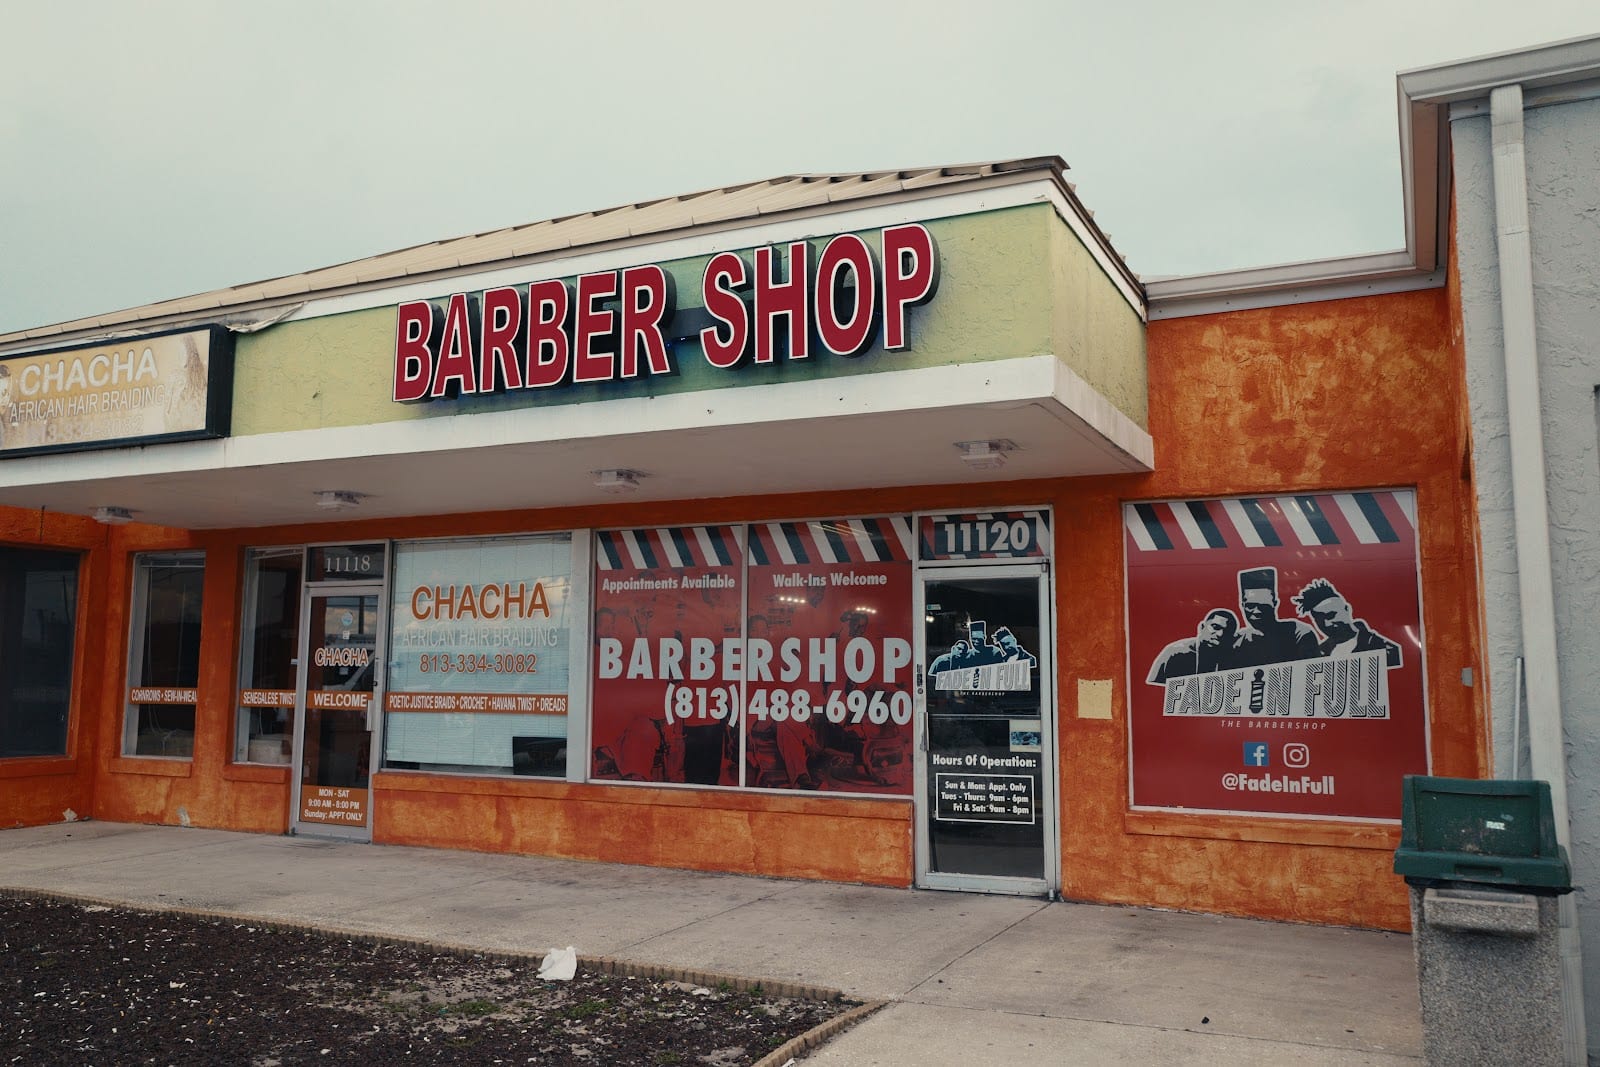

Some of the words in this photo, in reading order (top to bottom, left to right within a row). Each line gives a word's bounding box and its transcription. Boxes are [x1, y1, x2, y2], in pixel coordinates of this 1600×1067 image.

[392, 264, 678, 403] BARBER
[700, 223, 939, 369] SHOP
[19, 347, 159, 396] CHACHA
[10, 398, 64, 423] AFRICAN
[67, 393, 98, 417] HAIR
[101, 384, 165, 412] BRAIDING
[944, 520, 1030, 552] 11120
[325, 555, 371, 572] 11118
[602, 577, 678, 594] Appointments
[681, 574, 736, 590] Available
[773, 573, 826, 588] Walk-Ins
[831, 571, 887, 587] Welcome
[411, 582, 551, 620] CHACHA
[402, 627, 456, 648] AFRICAN
[459, 627, 490, 647] HAIR
[493, 625, 558, 648] BRAIDING
[314, 647, 369, 667] CHACHA
[419, 653, 537, 674] 813-334-3082
[599, 636, 912, 684] BARBERSHOP
[936, 670, 971, 689] FADE
[996, 662, 1030, 689] FULL
[131, 689, 160, 701] CORNROWS
[1164, 671, 1244, 714] FADE
[1304, 655, 1386, 718] FULL
[243, 691, 278, 705] SENEGALESE
[313, 692, 368, 708] WELCOME
[389, 695, 409, 708] POETIC
[410, 695, 433, 709] JUSTICE
[434, 696, 456, 709] BRAIDS
[459, 696, 488, 710] CROCHET
[492, 697, 516, 711] HAVANA
[517, 697, 537, 711] TWIST
[540, 697, 566, 712] DREADS
[664, 682, 740, 728] (813)
[749, 689, 913, 726] 488-6960
[1221, 719, 1241, 729] THE
[1248, 720, 1327, 730] BARBERSHOP
[933, 754, 962, 766] Hours
[965, 754, 977, 766] Of
[980, 755, 1037, 769] Operation:
[318, 788, 333, 797] MON
[337, 789, 350, 798] SAT
[944, 781, 958, 789] Sun
[959, 781, 965, 789] &
[967, 781, 985, 790] Mon:
[1010, 783, 1026, 793] Only
[1221, 773, 1335, 795] @FadeInFull
[321, 800, 331, 808] AM
[350, 802, 360, 810] PM
[941, 792, 957, 800] Tues
[964, 792, 986, 801] Thurs:
[988, 793, 1005, 802] 9am
[1012, 794, 1029, 804] 6pm
[328, 811, 346, 819] APPT
[346, 812, 363, 821] ONLY
[953, 803, 962, 811] Fri
[964, 803, 970, 812] &
[972, 804, 986, 812] Sat:
[989, 804, 1005, 813] 9am
[1012, 805, 1029, 815] 8pm
